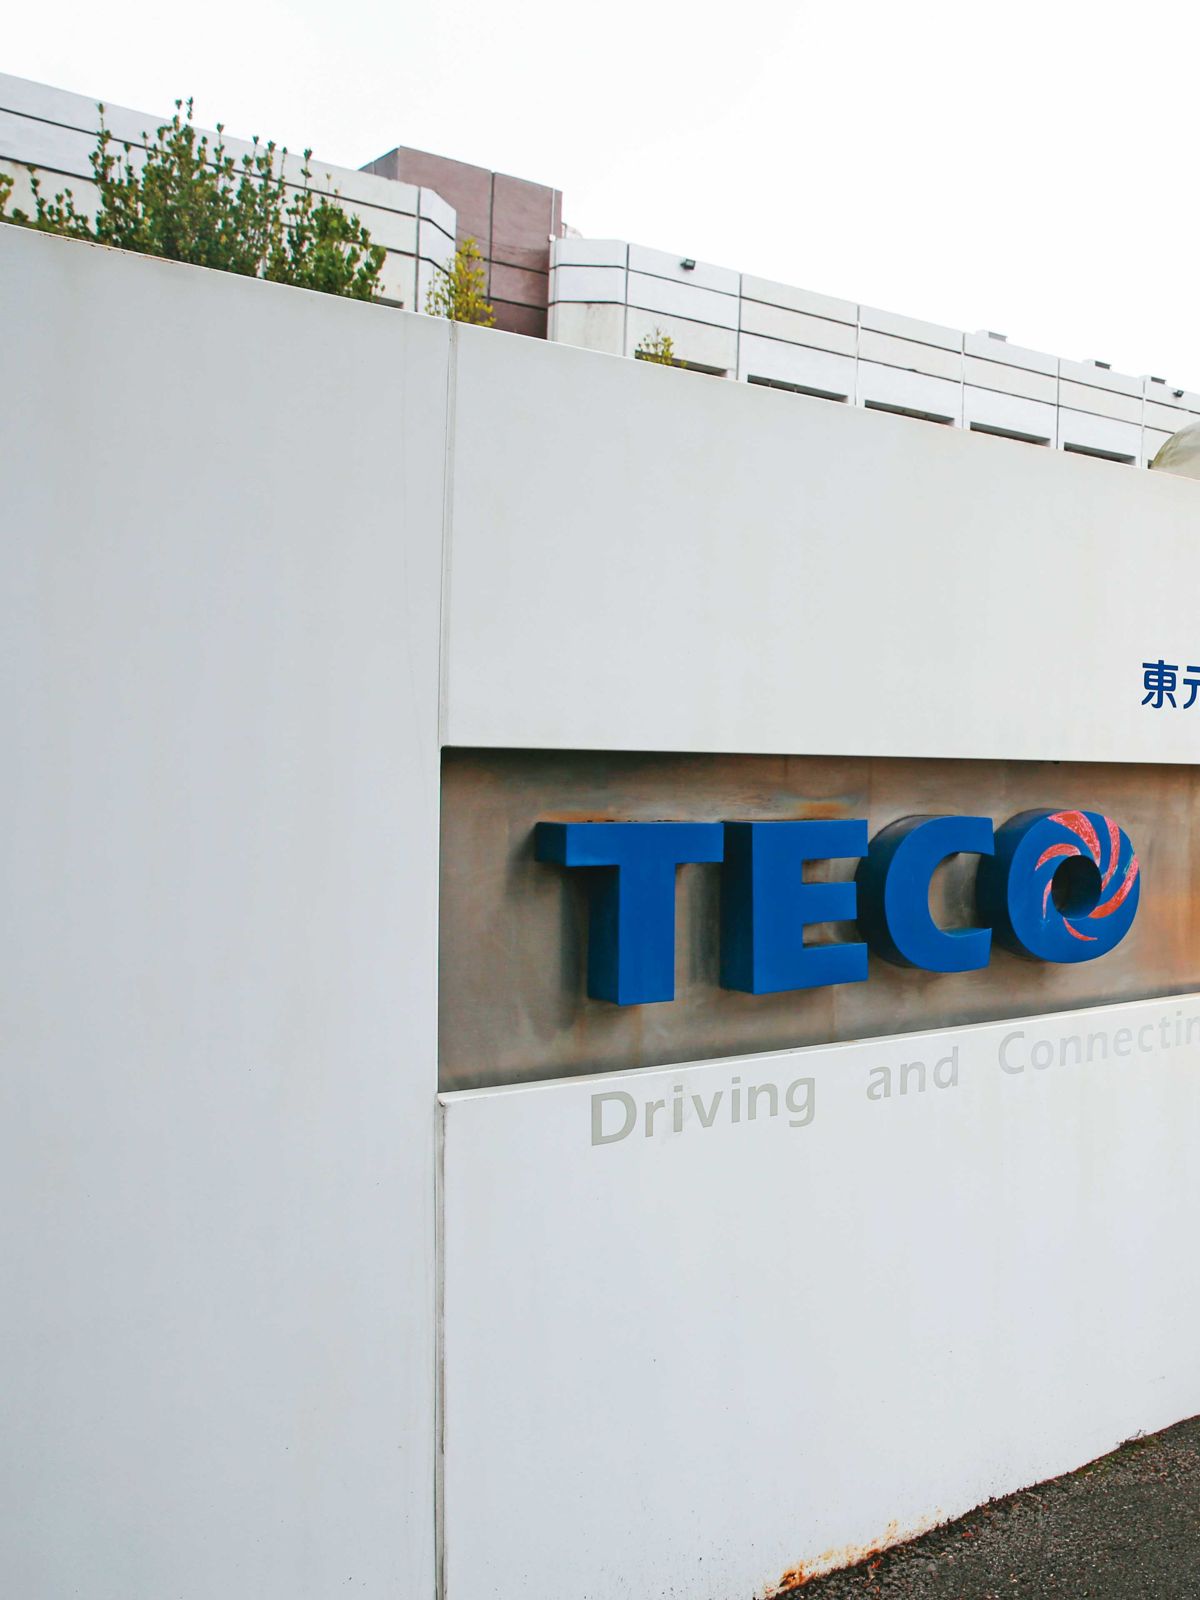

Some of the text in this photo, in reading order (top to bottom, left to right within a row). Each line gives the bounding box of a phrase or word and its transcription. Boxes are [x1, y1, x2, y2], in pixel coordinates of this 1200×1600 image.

[534, 808, 1140, 1006] TECO
[590, 1076, 816, 1146] Driving
[866, 1046, 960, 1100] and
